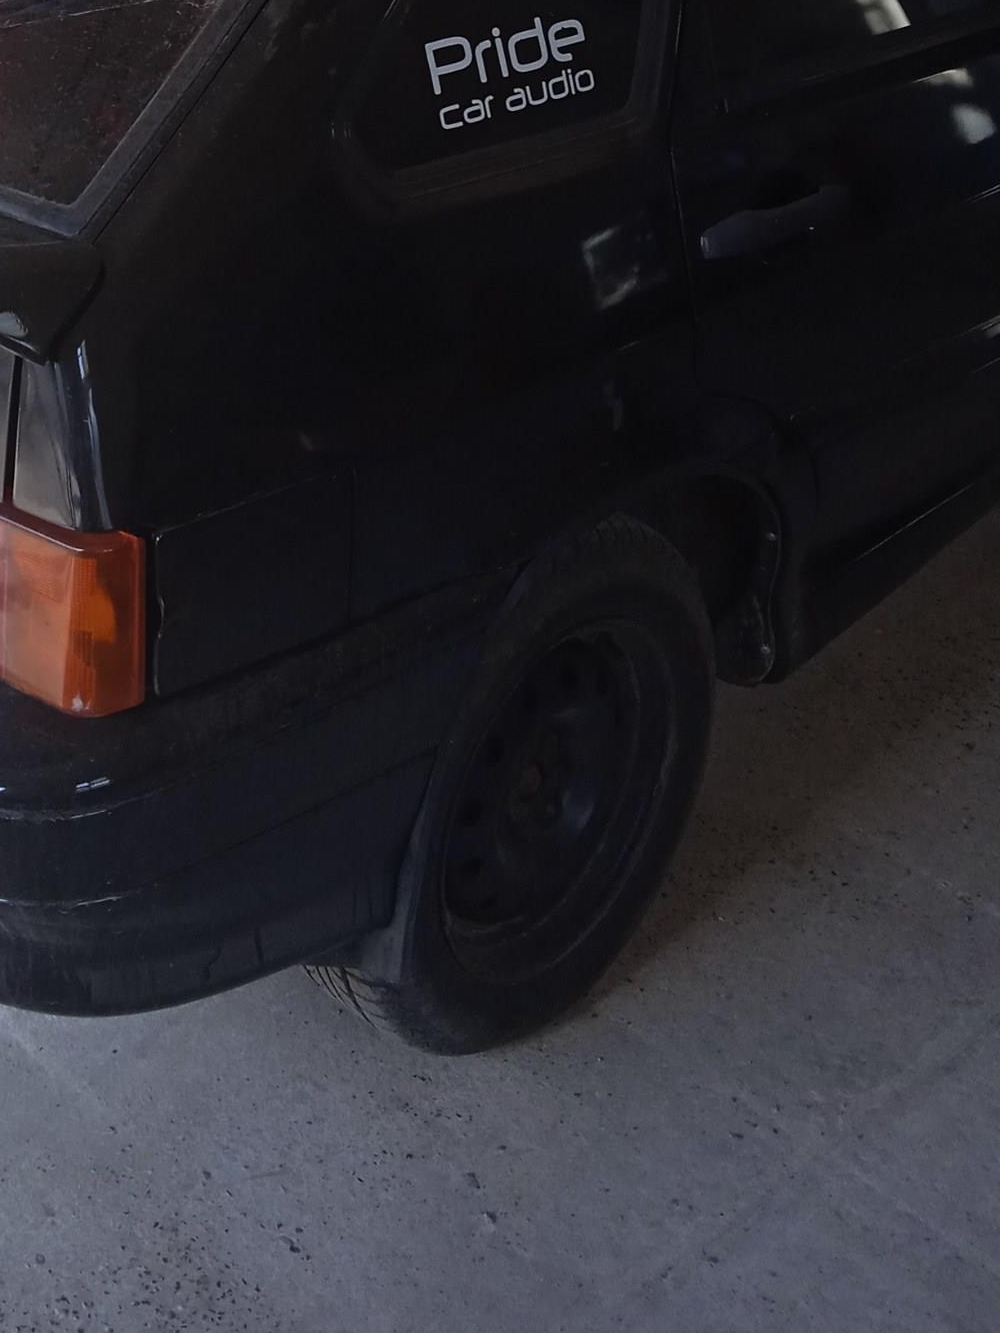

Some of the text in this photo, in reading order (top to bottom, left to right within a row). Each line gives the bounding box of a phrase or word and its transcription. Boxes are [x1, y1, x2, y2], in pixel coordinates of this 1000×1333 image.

[424, 16, 586, 96] Pride
[439, 68, 595, 130] car audio
